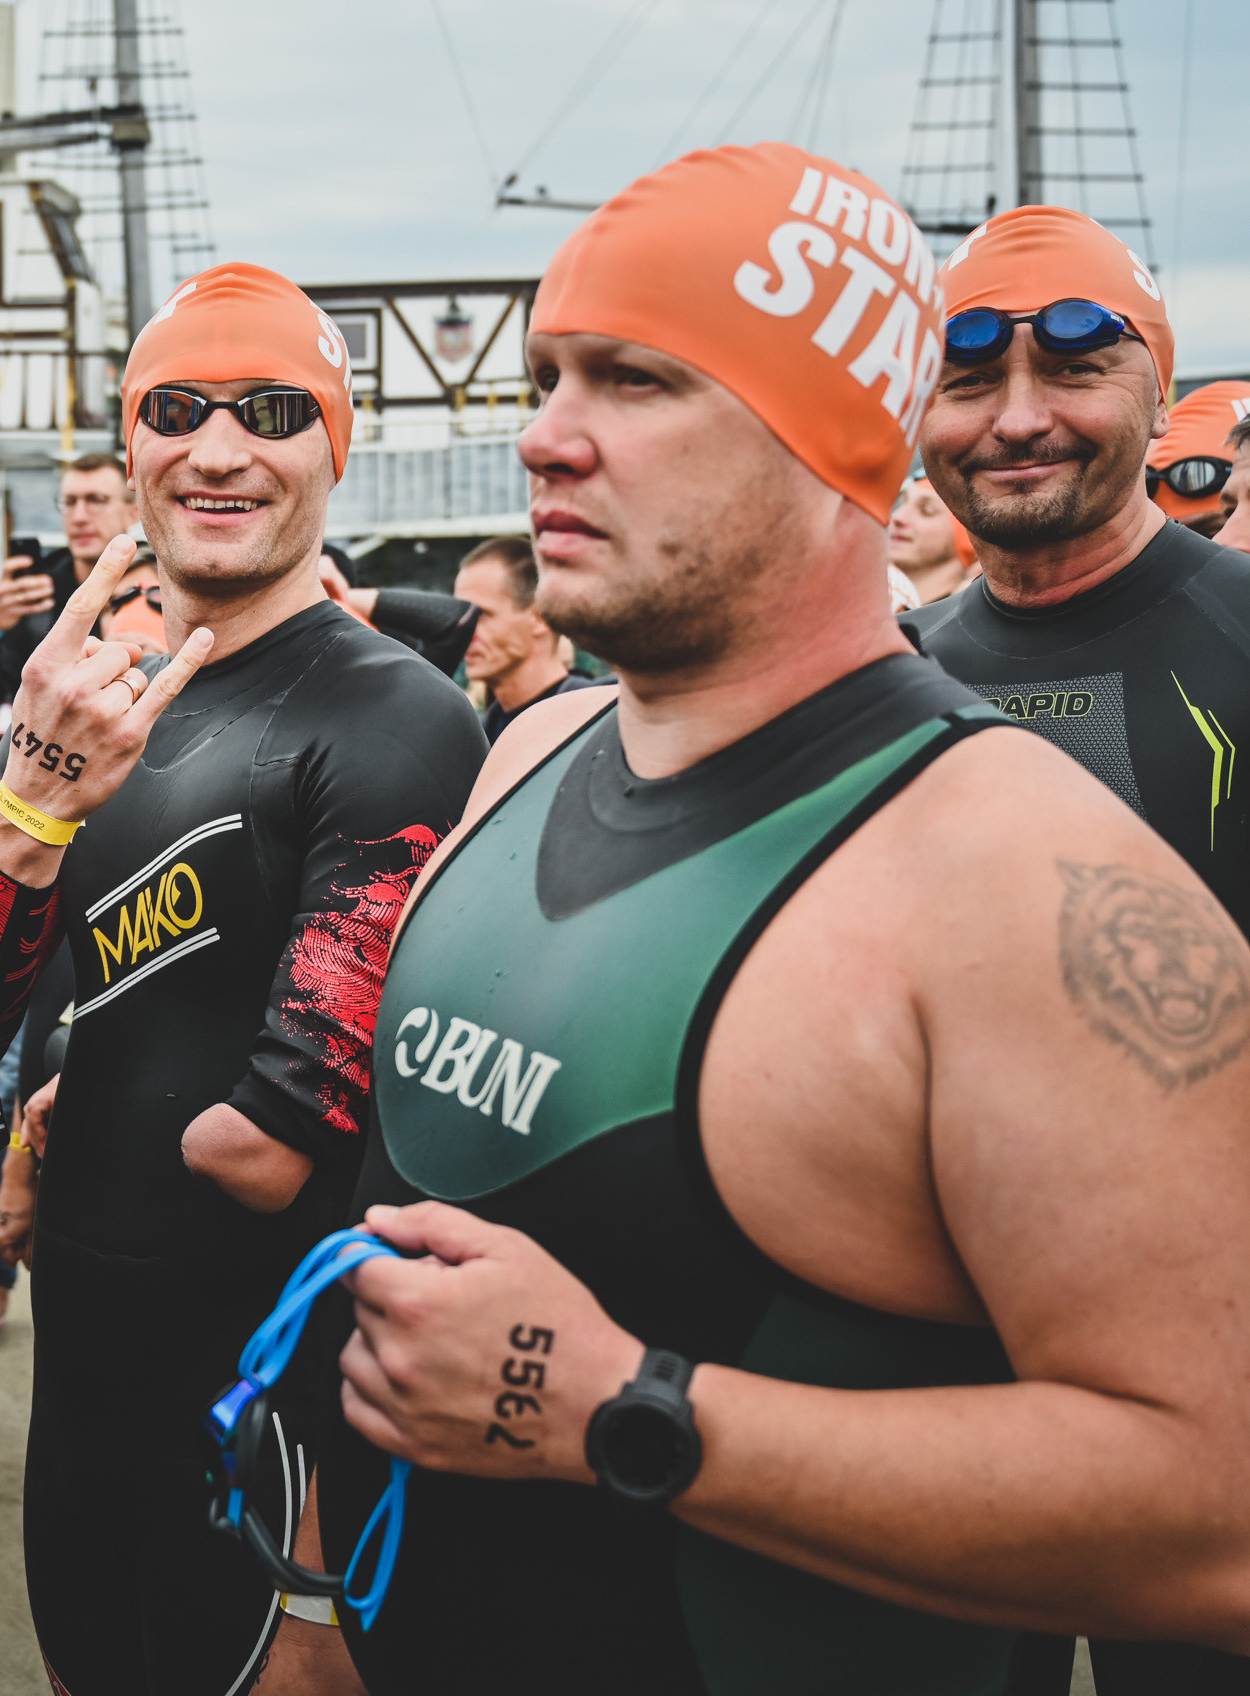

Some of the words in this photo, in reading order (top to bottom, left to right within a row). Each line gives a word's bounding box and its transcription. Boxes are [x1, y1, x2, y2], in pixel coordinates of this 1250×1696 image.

[789, 166, 936, 305] IRON
[733, 220, 943, 449] STAR
[11, 722, 87, 782] 5547
[92, 862, 204, 984] MAKO
